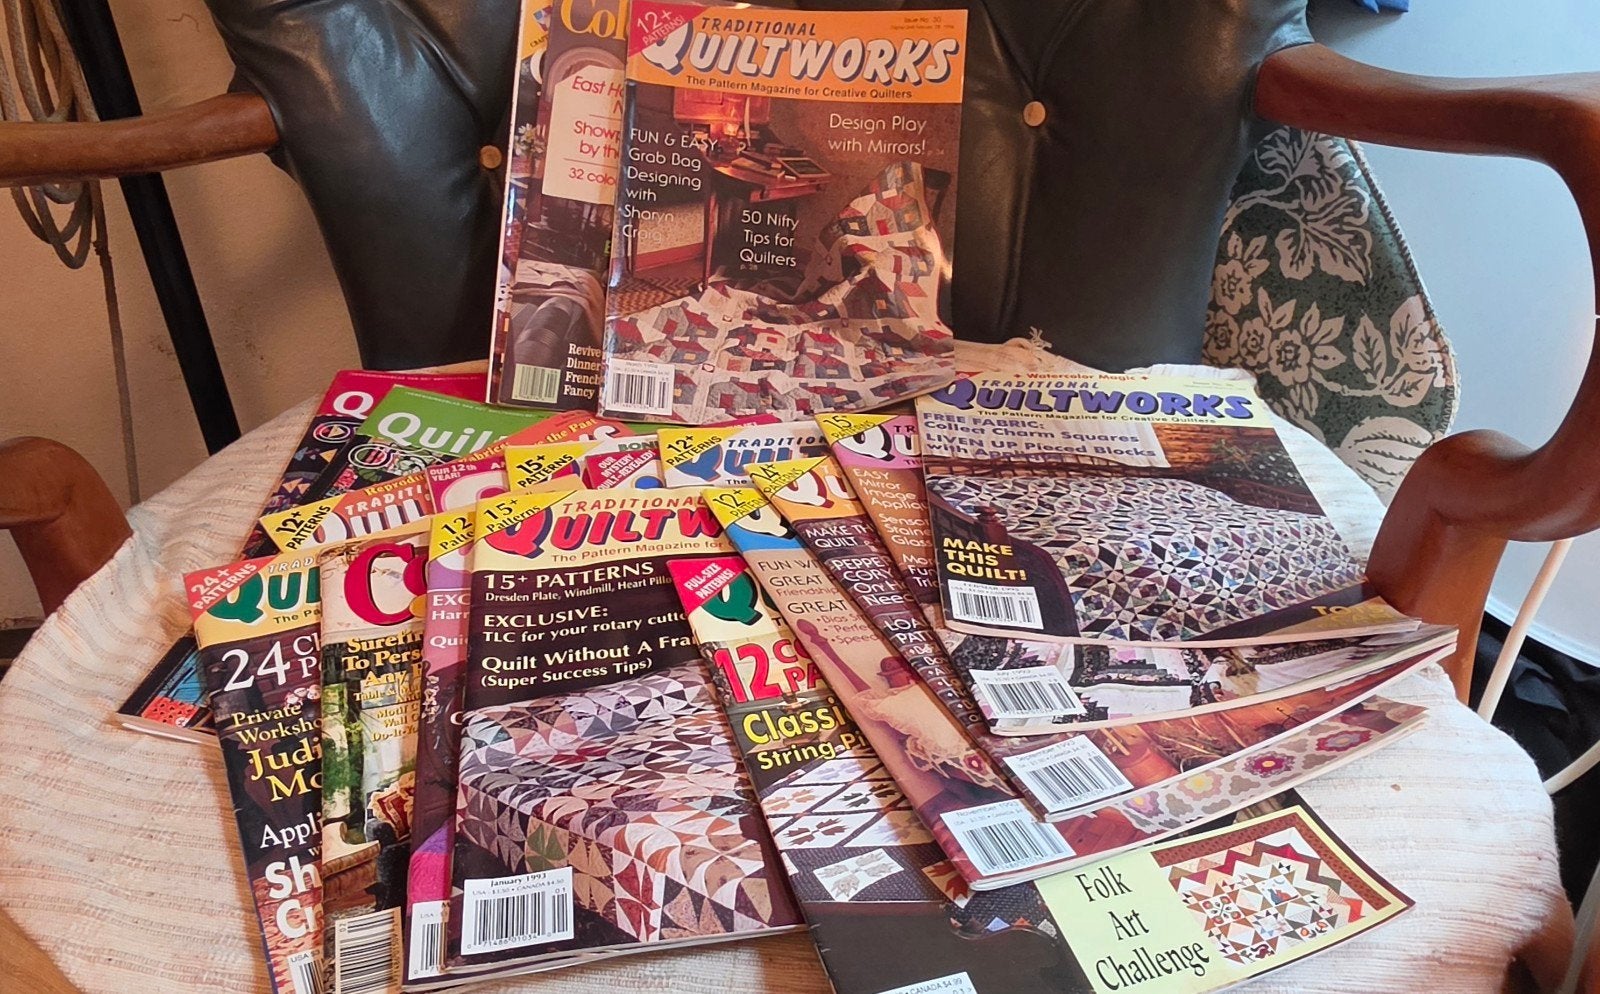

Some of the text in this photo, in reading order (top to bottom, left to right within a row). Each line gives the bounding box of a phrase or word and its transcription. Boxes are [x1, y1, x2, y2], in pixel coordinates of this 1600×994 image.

[636, 10, 672, 34] 12+
[642, 15, 686, 46] PATTERNS!
[702, 17, 816, 37] TRADITIONAL
[641, 19, 960, 87] QUILTWORKS
[571, 76, 606, 95] East
[686, 75, 912, 99] The Pattern Magazine for Creative Quilters
[829, 113, 927, 136] Design Play
[579, 140, 600, 158] by
[630, 128, 720, 151] FUN & EASY
[828, 138, 862, 152] with
[867, 139, 926, 155] Mirrors!
[628, 147, 702, 172] Grab Bag
[568, 167, 585, 180] 32
[626, 166, 702, 191] Designing
[625, 187, 657, 202] with
[622, 204, 675, 225] Sharyn
[741, 210, 800, 231] 50 Nifty
[621, 224, 663, 244] Craig
[743, 229, 796, 248] Tips for
[739, 248, 797, 268] Quilters
[562, 384, 596, 399] Fancy
[981, 379, 1099, 389] TRADITIONAL
[929, 378, 1254, 419] QUILTWORKS
[923, 412, 1045, 430] FREE FABRIC:
[1002, 410, 1043, 419] Pattern
[1120, 415, 1168, 423] Creative
[378, 412, 508, 456] Quil
[545, 430, 568, 443] the
[924, 420, 1140, 443] Collect Charm Squares
[666, 435, 695, 455] 12+
[666, 435, 723, 467] PATTERNS
[926, 433, 1157, 458] LIVEN UP Pieced Blocks
[926, 443, 968, 455] with
[429, 463, 478, 476] OUR 12th
[516, 454, 546, 475] 15+
[517, 453, 574, 488] PATTERNS
[598, 456, 618, 469] OUR
[601, 453, 635, 478] MYSTERY
[750, 463, 778, 482] 14+
[431, 471, 461, 482] YEAR!
[763, 467, 804, 494] PATTERNS
[852, 468, 890, 480] EASY
[858, 478, 902, 490] Mirror
[712, 489, 744, 509] 12+
[863, 487, 917, 501] Image
[483, 499, 519, 521] 15+
[486, 503, 541, 534] Patterns
[275, 510, 303, 534] 12+
[286, 505, 331, 550] PATTERNS
[441, 516, 474, 536] 12
[805, 525, 853, 539] MAKE
[551, 540, 723, 564] The Pattern Magazine for
[814, 536, 859, 549] QUILT
[943, 537, 1014, 556] MAKE
[758, 560, 790, 572] FUN
[943, 549, 999, 567] THIS
[191, 567, 231, 595] 24+
[484, 561, 654, 590] 15+ PATTERNS
[684, 562, 722, 592] FULL-SIZE
[769, 575, 824, 587] GREAT
[843, 568, 895, 582] CORY
[946, 562, 1028, 581] QUILT!
[192, 562, 258, 611] PATTERNS
[485, 591, 530, 603] Dresden
[532, 589, 561, 602] Plate,
[564, 581, 615, 599] Windmill,
[617, 578, 647, 591] Heart
[695, 567, 737, 600] PATTERNS!
[853, 582, 883, 595] On
[483, 605, 608, 628] EXCLUSIVE:
[787, 600, 849, 615] GREAT
[273, 614, 301, 625] The
[482, 617, 643, 644] TLC for your rotary
[221, 640, 291, 693] 24
[341, 655, 370, 672] To
[481, 640, 653, 675] Quilt Without A
[364, 670, 409, 688] Any
[480, 657, 653, 691] (Super Success Tips)
[713, 642, 784, 704] 12
[231, 705, 302, 728] Private
[756, 741, 838, 771] String
[490, 872, 548, 889] January 1993
[1074, 865, 1134, 902] Folk
[1108, 908, 1150, 941] Art
[290, 953, 310, 963] USA
[1095, 942, 1211, 991] Challenge
